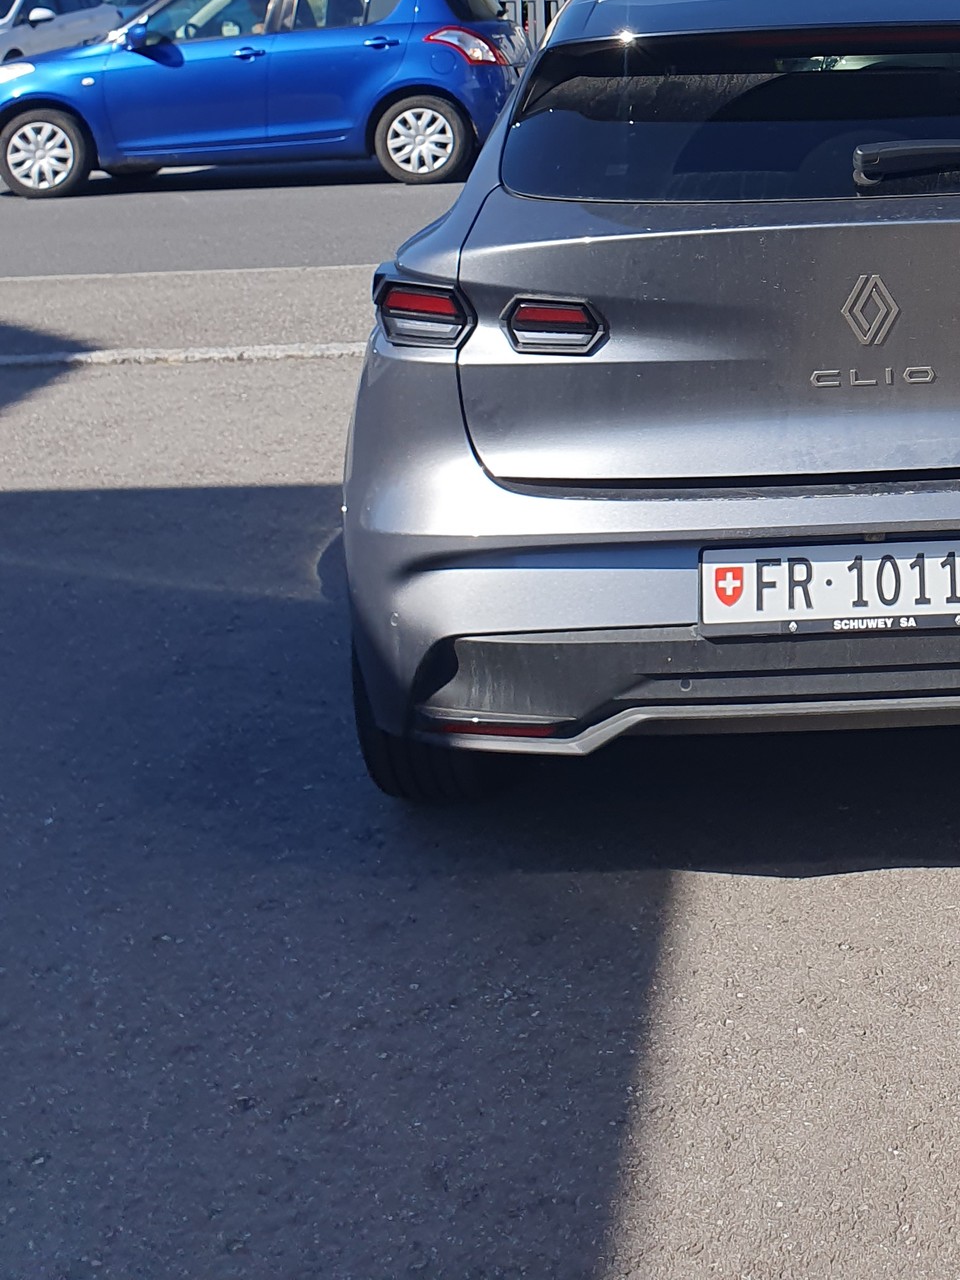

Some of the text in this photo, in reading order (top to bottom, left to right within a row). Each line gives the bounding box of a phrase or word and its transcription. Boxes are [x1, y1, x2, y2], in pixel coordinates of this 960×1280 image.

[810, 366, 935, 387] CLIO
[833, 617, 917, 630] SCHUWEY SA
